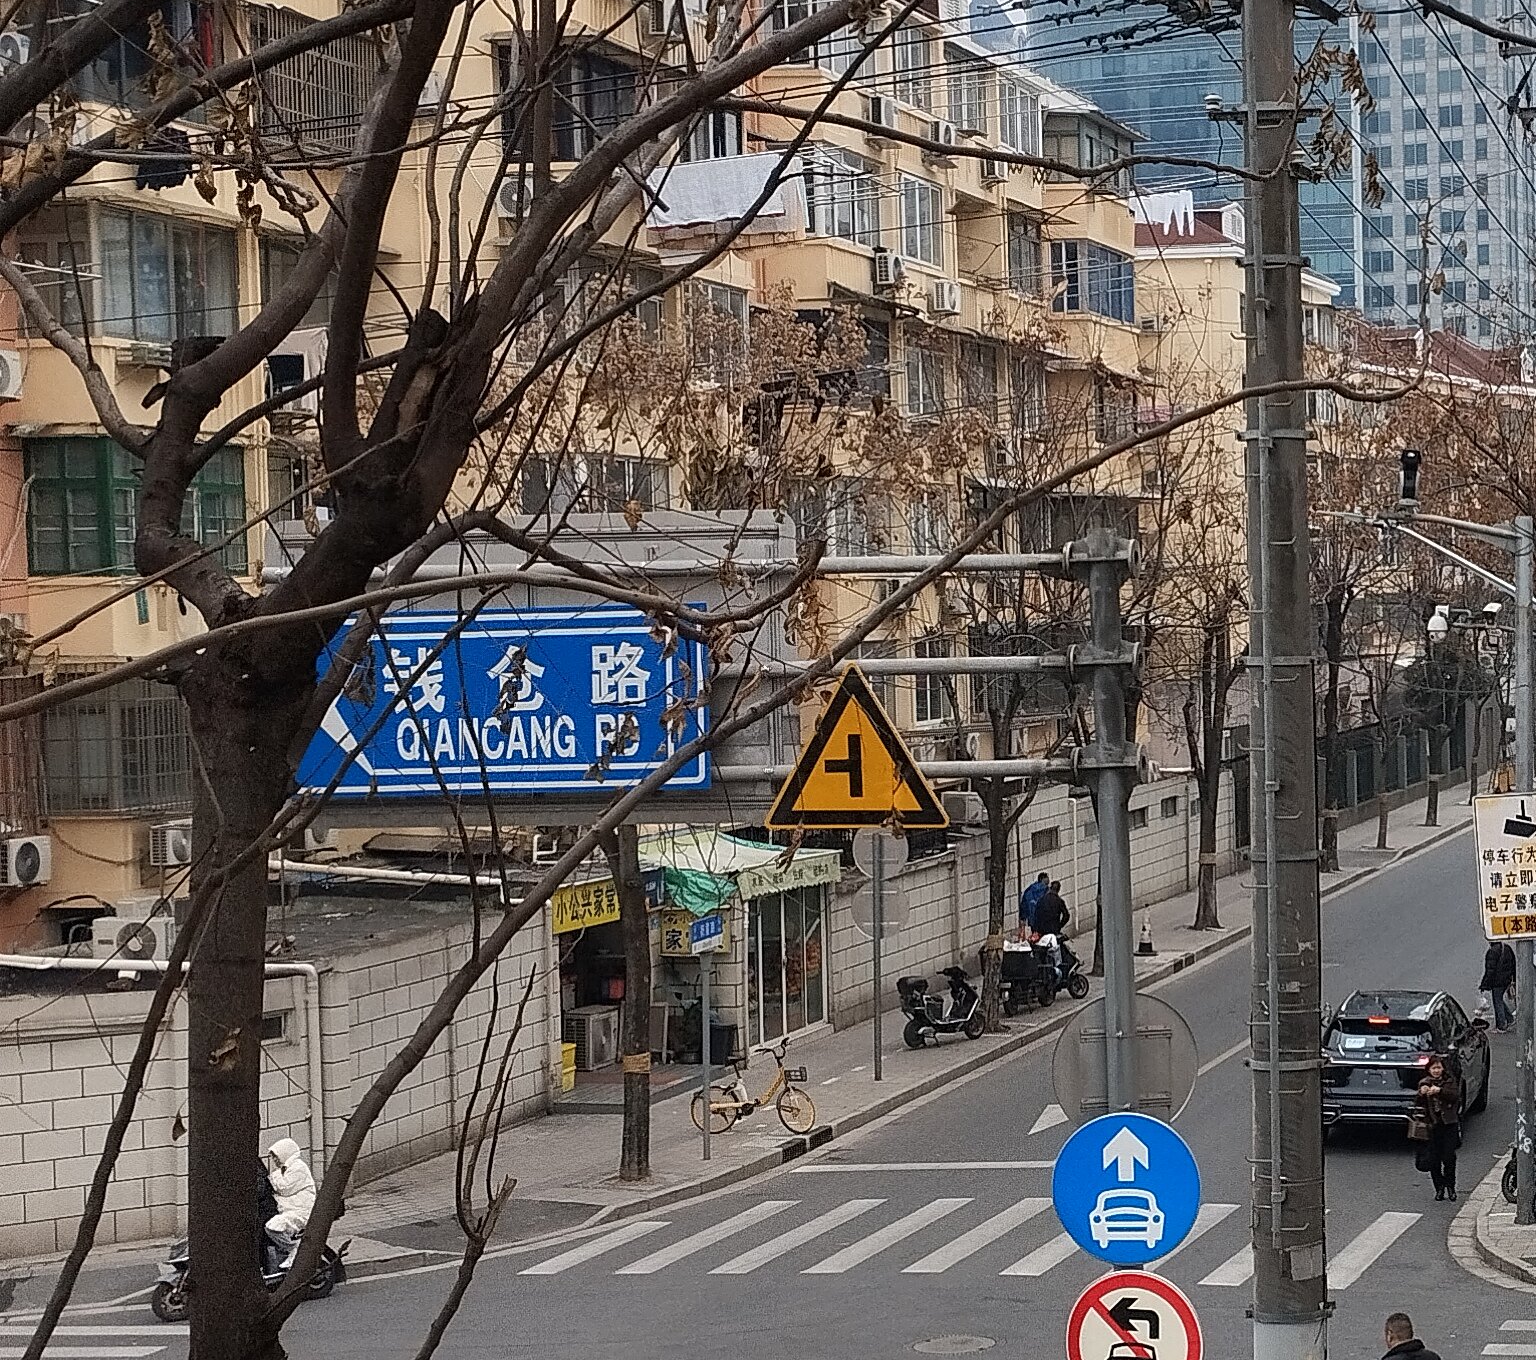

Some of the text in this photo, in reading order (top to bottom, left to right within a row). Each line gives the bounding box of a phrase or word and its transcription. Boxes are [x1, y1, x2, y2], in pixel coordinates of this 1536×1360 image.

[382, 642, 651, 714] 钱仓路
[396, 713, 640, 761] QIANCANG RD
